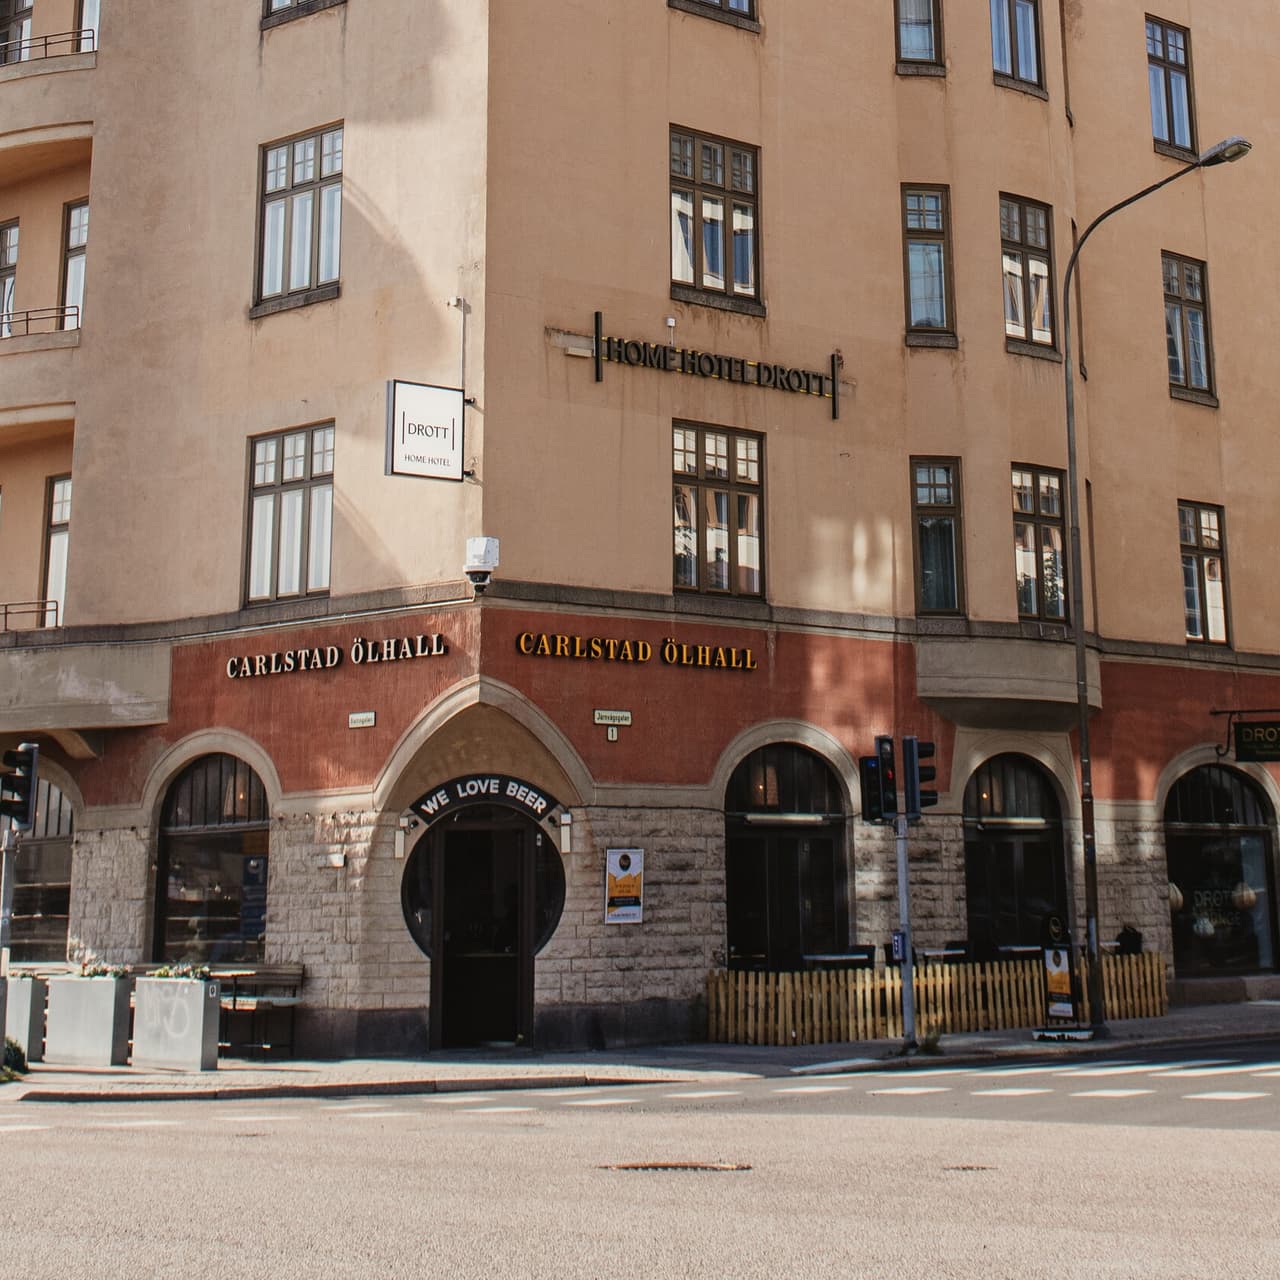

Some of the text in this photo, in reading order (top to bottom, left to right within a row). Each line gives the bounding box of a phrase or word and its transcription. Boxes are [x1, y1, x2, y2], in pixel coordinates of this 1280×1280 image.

[606, 336, 833, 395] HOME HOTEL DROTT
[408, 423, 449, 439] DROTT
[405, 454, 451, 467] HOME HOTEL
[226, 633, 445, 679] CARLSTAD ÖLHALL
[519, 632, 758, 669] CARLSTAD ÖLHALL
[421, 778, 548, 815] WE LOVE BEER
